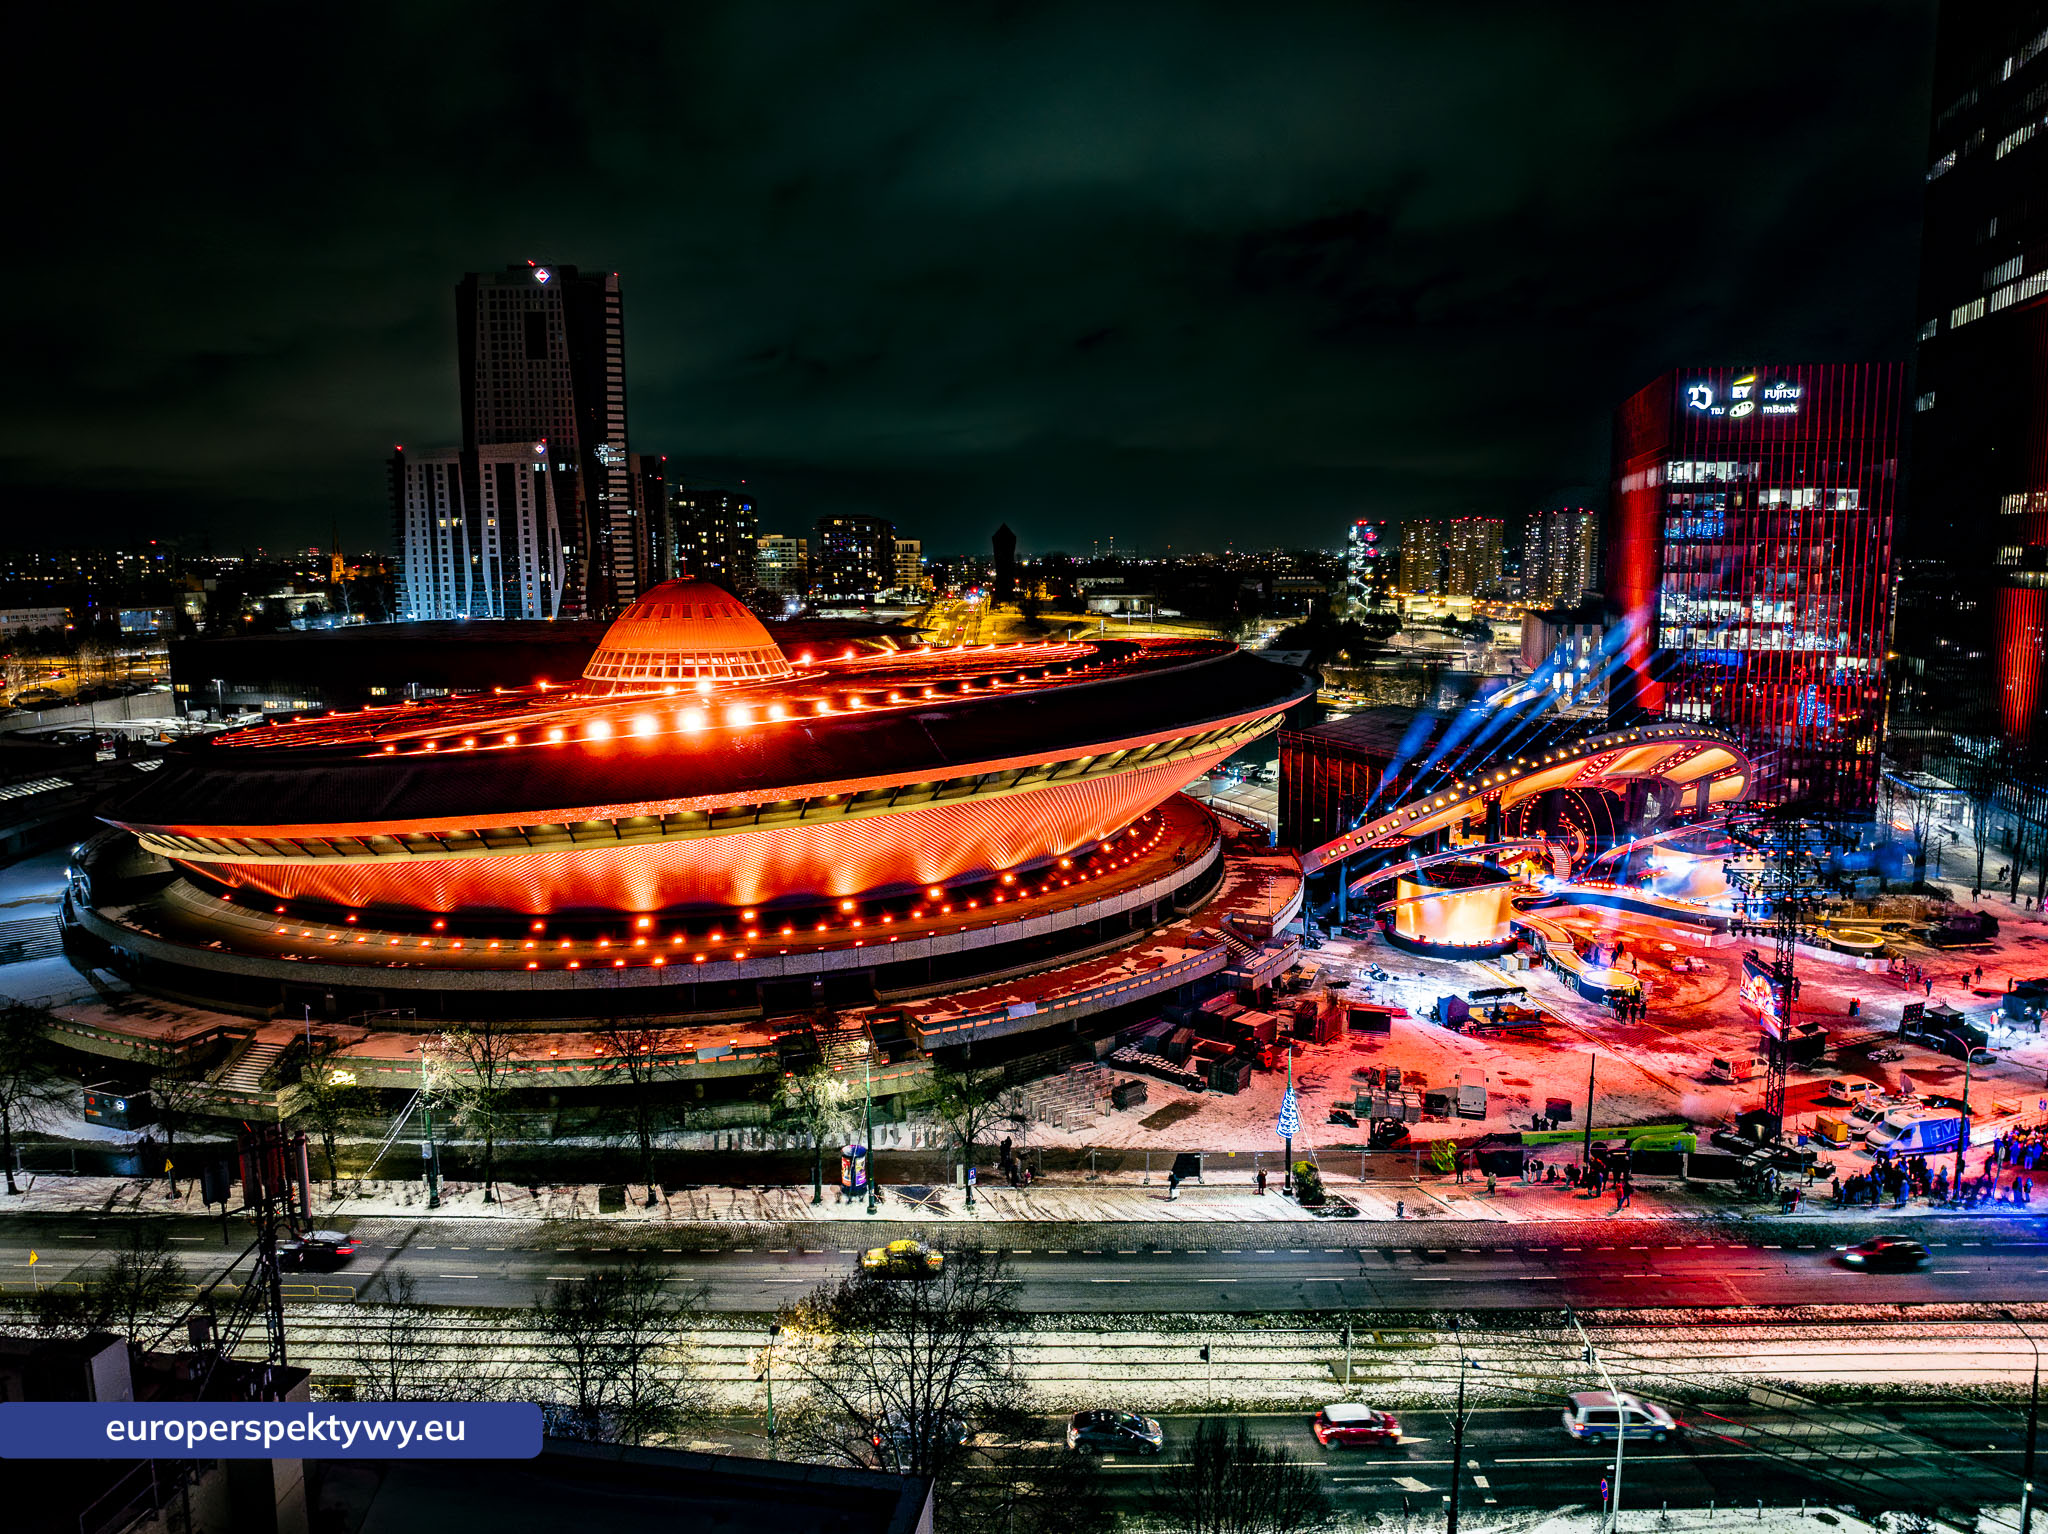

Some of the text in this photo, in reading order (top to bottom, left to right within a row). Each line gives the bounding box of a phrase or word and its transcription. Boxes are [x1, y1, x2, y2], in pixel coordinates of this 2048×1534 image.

[1732, 385, 1752, 399] EY
[1764, 388, 1801, 401] FUJITSU
[1762, 403, 1799, 414] mBank
